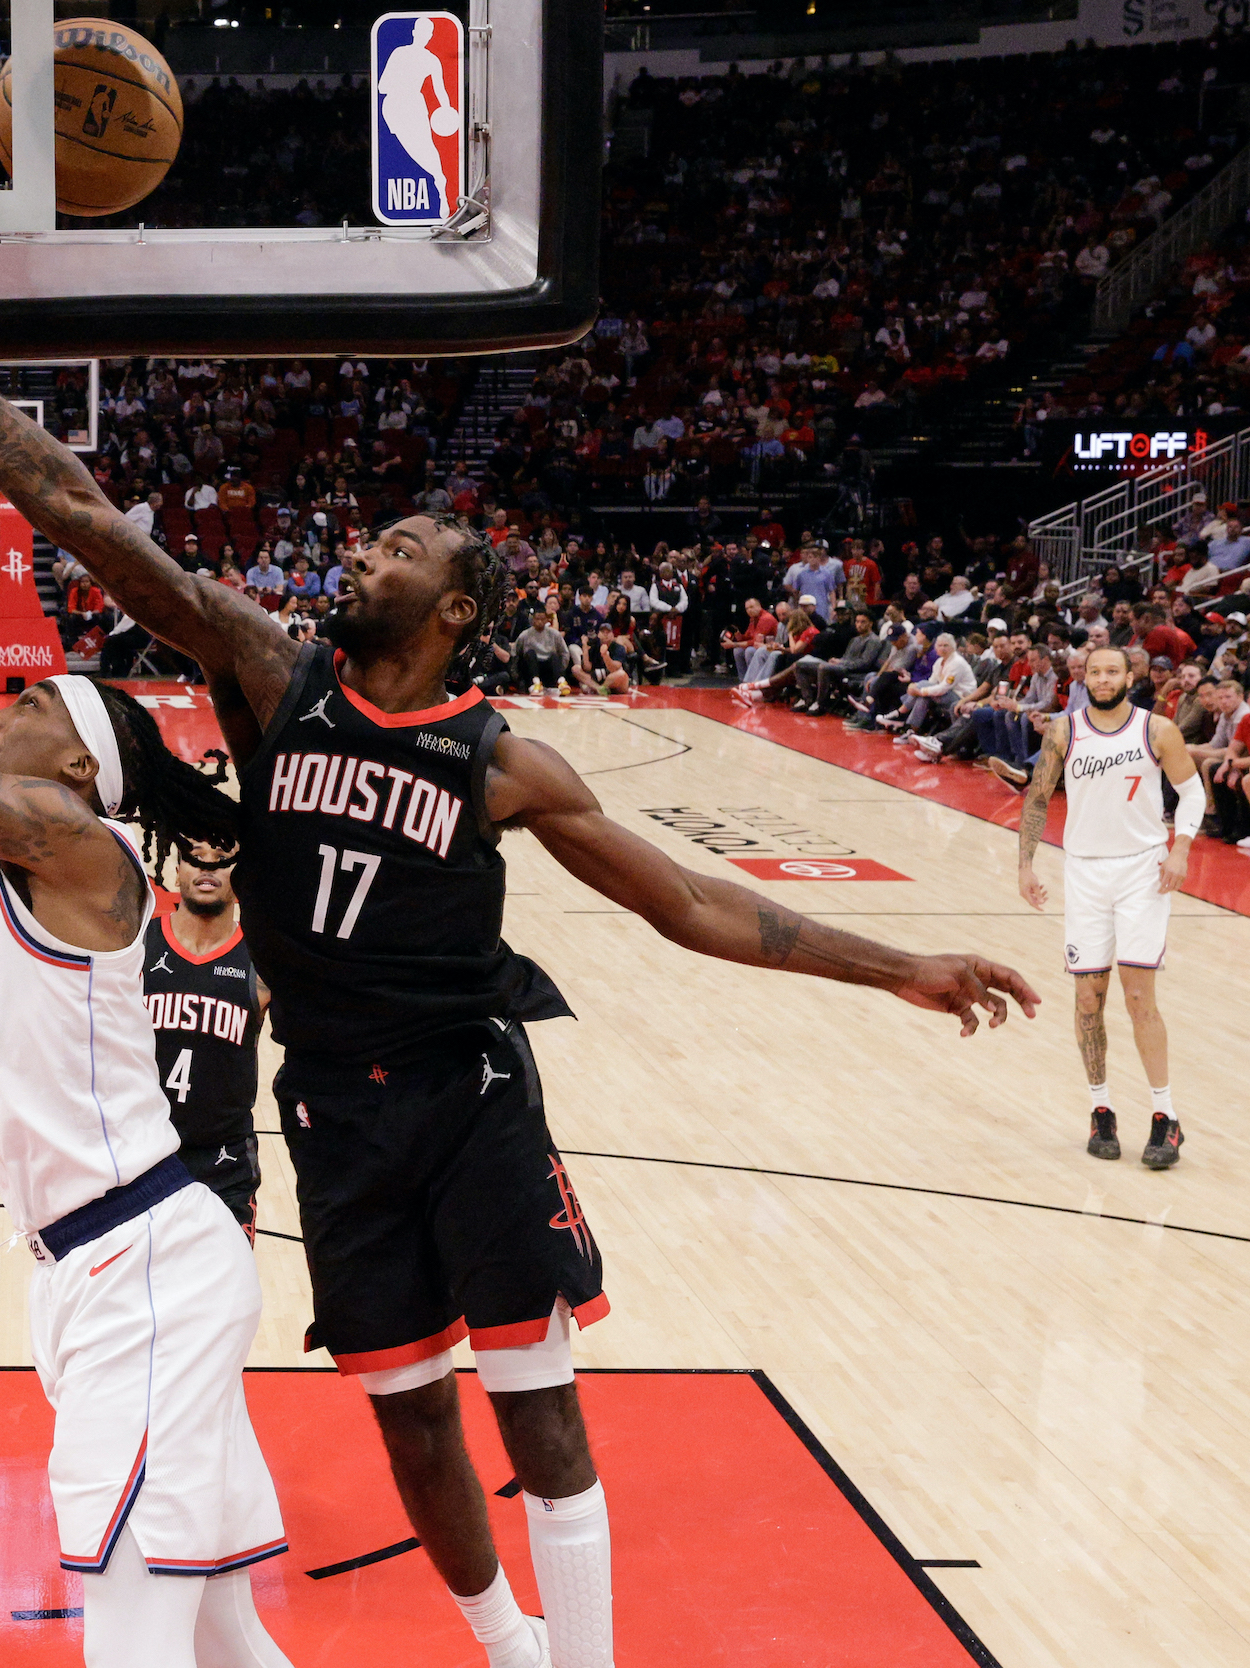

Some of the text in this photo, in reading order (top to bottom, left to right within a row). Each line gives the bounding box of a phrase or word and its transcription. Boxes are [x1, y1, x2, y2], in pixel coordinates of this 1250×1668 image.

[54, 27, 171, 95] Wilson
[387, 177, 430, 211] NBA
[1074, 431, 1188, 459] LIFTOFF
[415, 731, 471, 754] MEMORIAL
[415, 739, 471, 760] HERMANN
[1072, 748, 1144, 779] Clippers
[1124, 775, 1142, 802] 7
[268, 752, 463, 861] HOUSTON
[638, 807, 775, 855] TOYOTA
[310, 842, 382, 940] 17
[165, 1048, 193, 1104] 4
